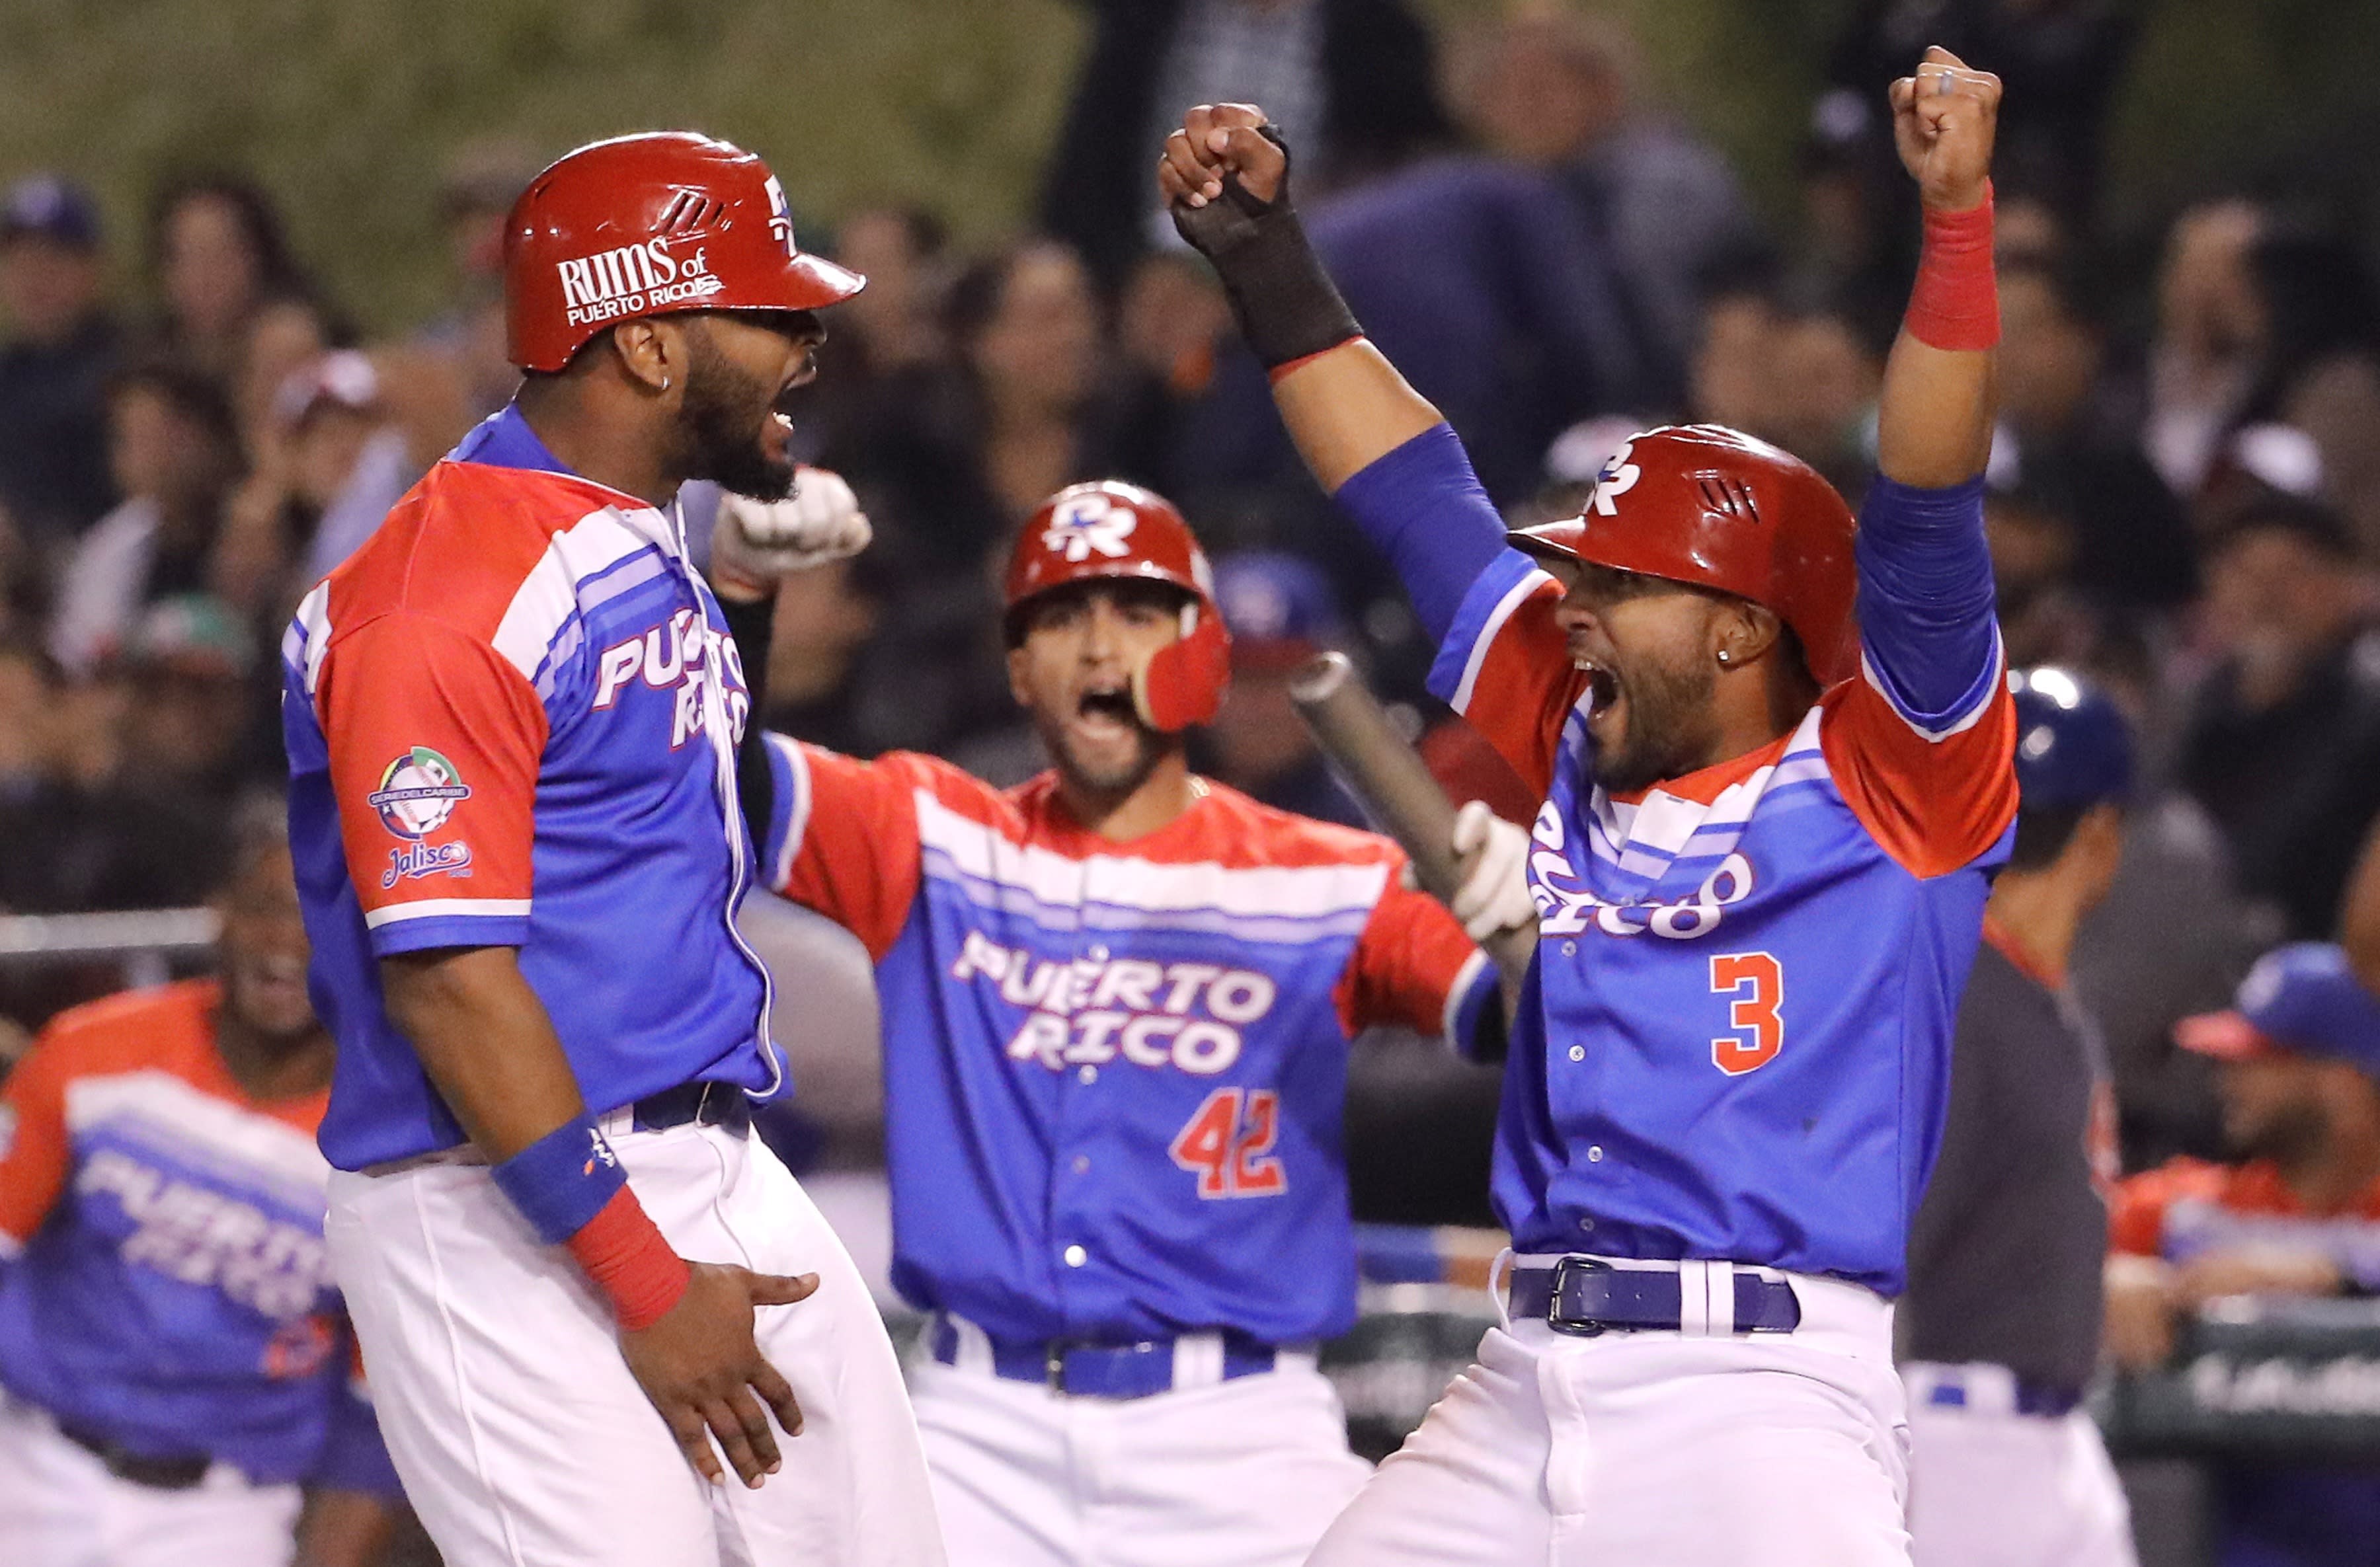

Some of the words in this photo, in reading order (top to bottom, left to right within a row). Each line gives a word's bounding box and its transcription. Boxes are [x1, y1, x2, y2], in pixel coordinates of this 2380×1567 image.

[649, 281, 695, 307] RICO
[681, 247, 708, 278] of
[1041, 495, 1136, 562] PR
[381, 843, 471, 888] Jalisco
[951, 929, 1277, 1024] PUERTO
[1006, 1009, 1242, 1079] RICO
[1709, 950, 1784, 1077] 3
[1168, 1086, 1289, 1201] 42
